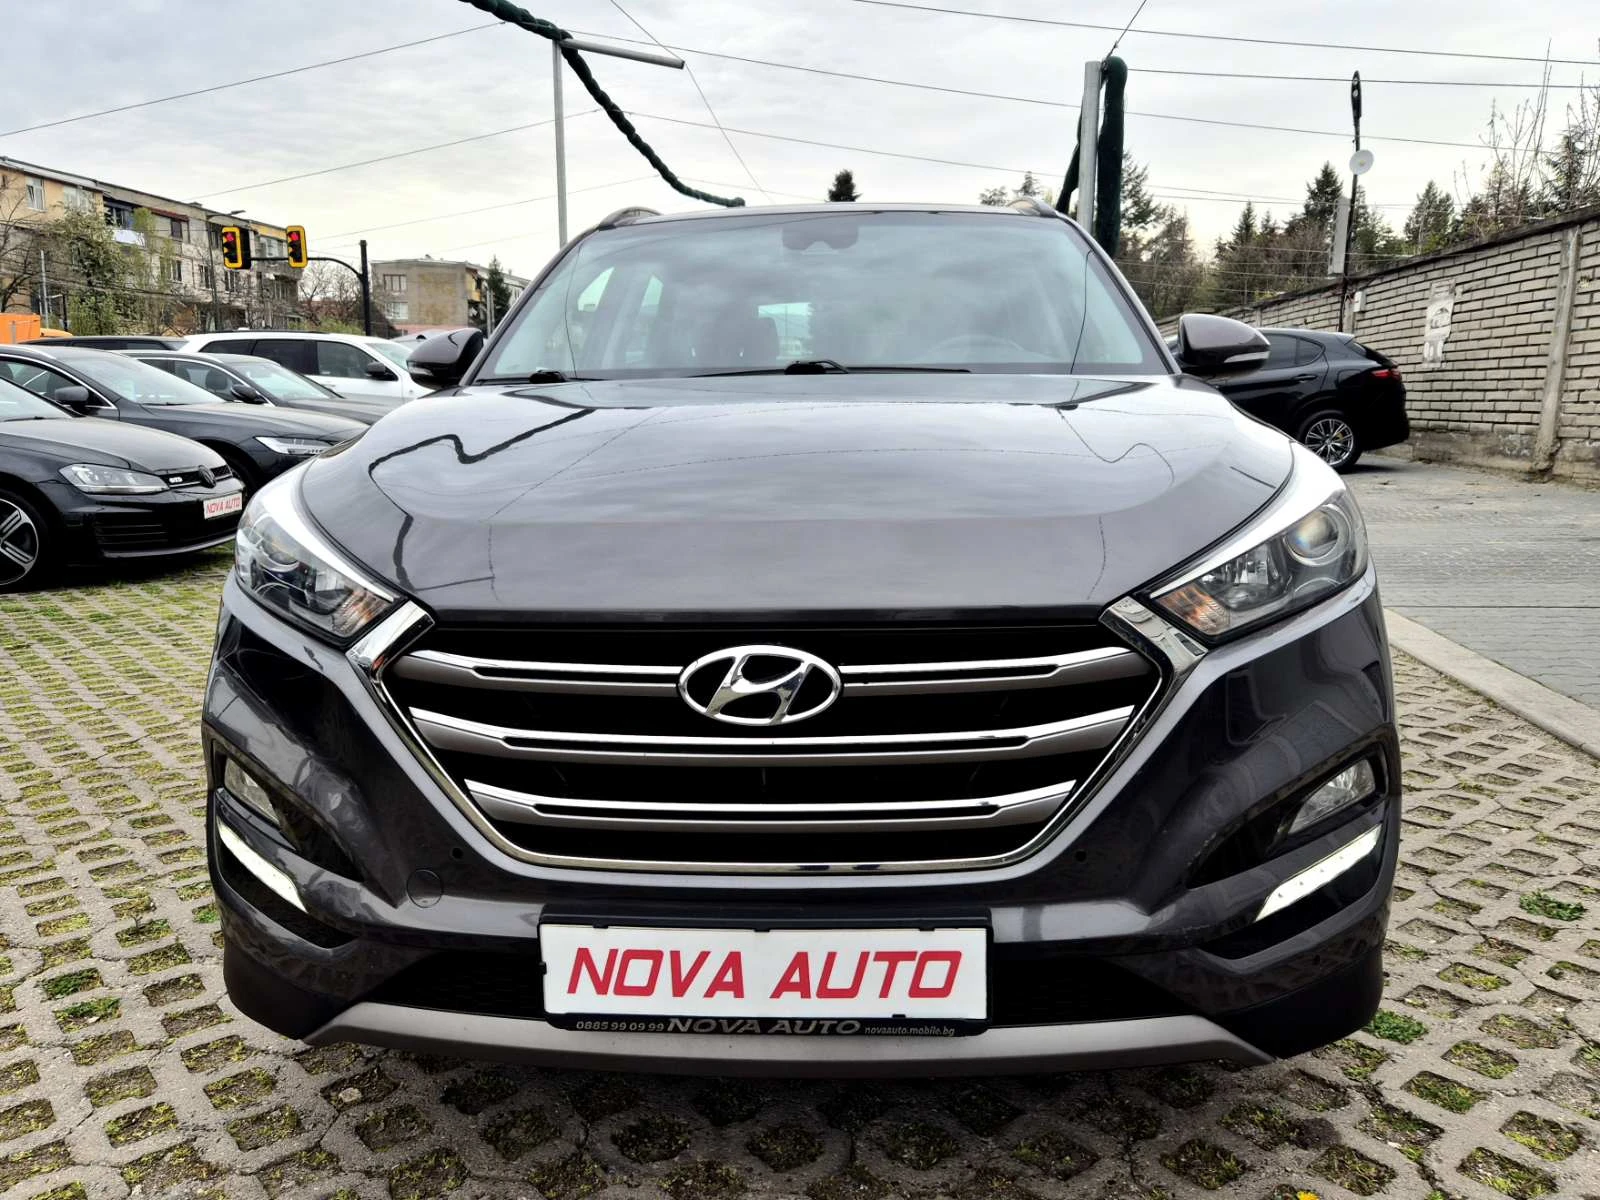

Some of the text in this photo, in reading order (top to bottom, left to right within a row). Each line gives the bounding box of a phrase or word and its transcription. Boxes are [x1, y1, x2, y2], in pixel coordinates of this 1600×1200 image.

[567, 948, 963, 999] NOVA AUTO
[576, 1021, 609, 1030] 0885
[629, 1022, 645, 1031] 09
[667, 1018, 761, 1033] NOVA
[767, 1019, 861, 1034] AUTO
[864, 1026, 955, 1037] novaauto.mobile.bg
